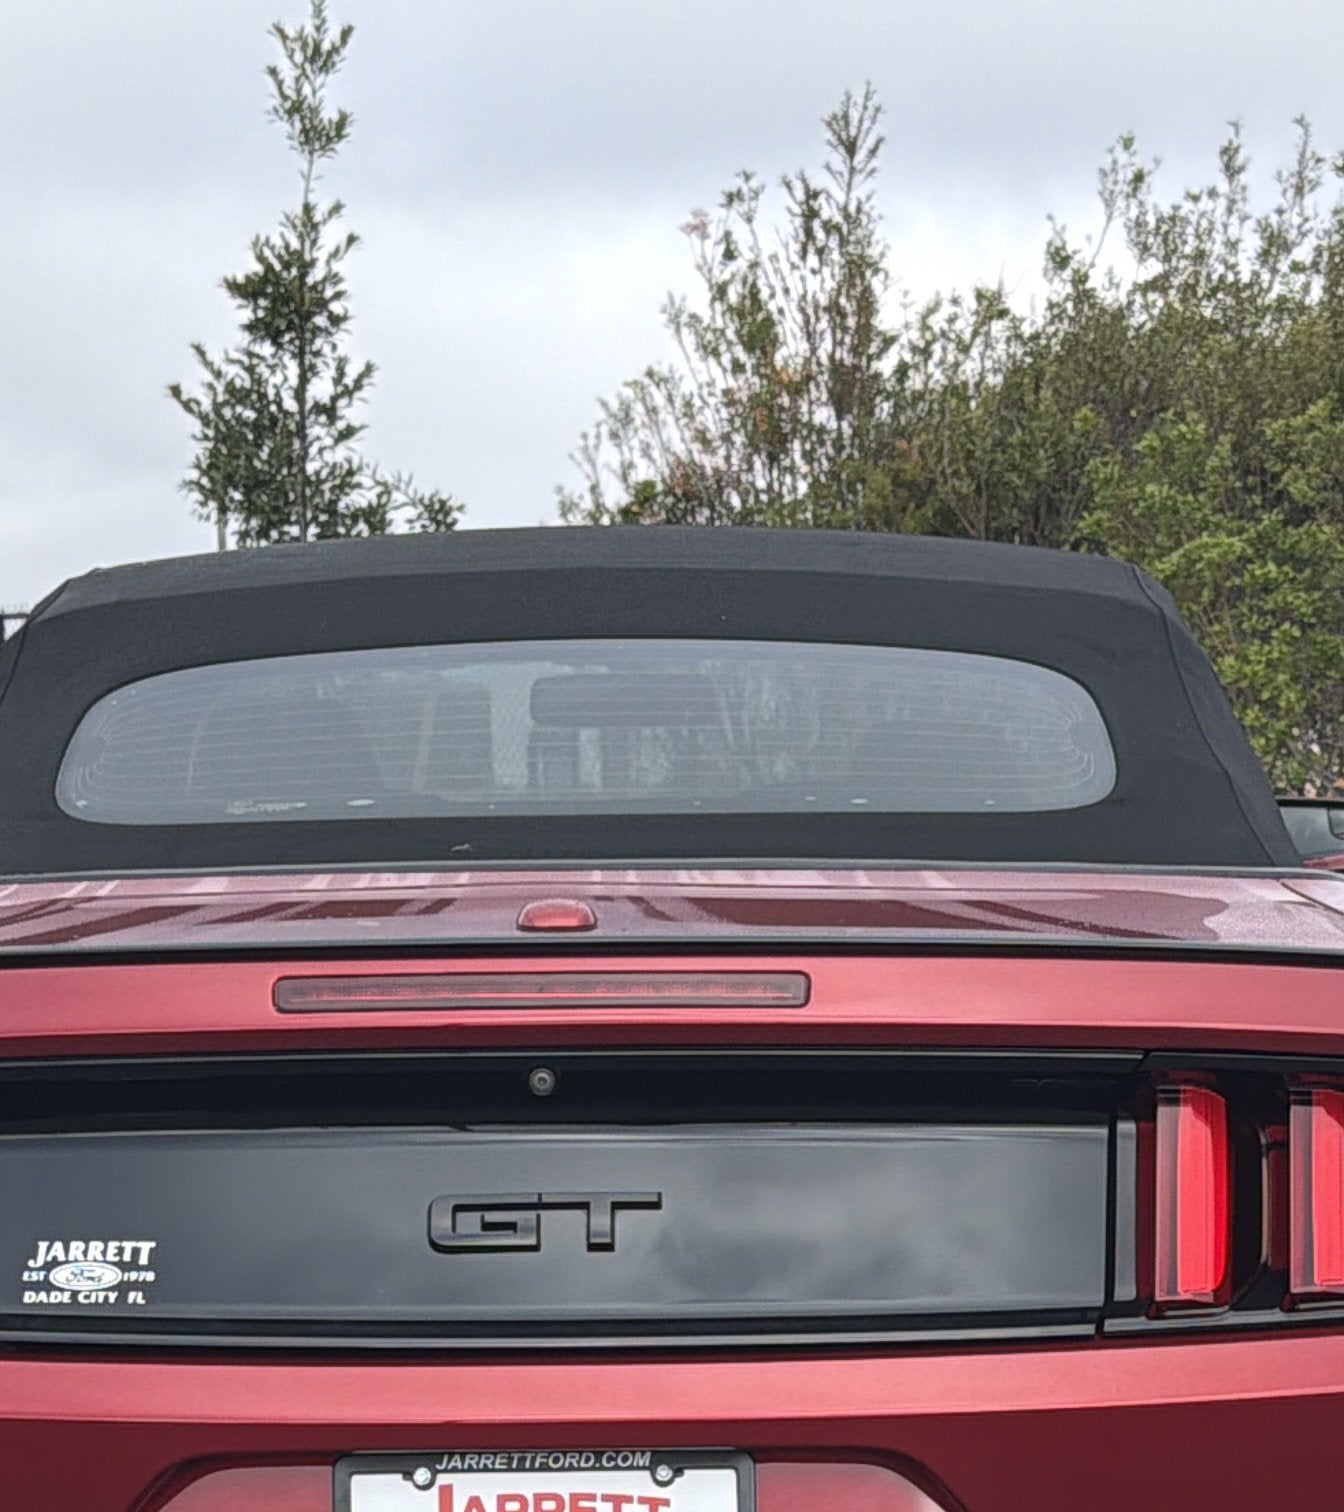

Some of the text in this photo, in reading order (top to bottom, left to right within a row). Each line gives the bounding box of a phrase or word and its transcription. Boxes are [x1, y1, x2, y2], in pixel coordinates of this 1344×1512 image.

[427, 1191, 662, 1254] GT
[27, 1240, 156, 1268] JARRETT
[21, 1270, 47, 1282] EST
[22, 1290, 146, 1305] DADE CITY FL
[435, 1451, 652, 1471] JARRETTFORD.COM
